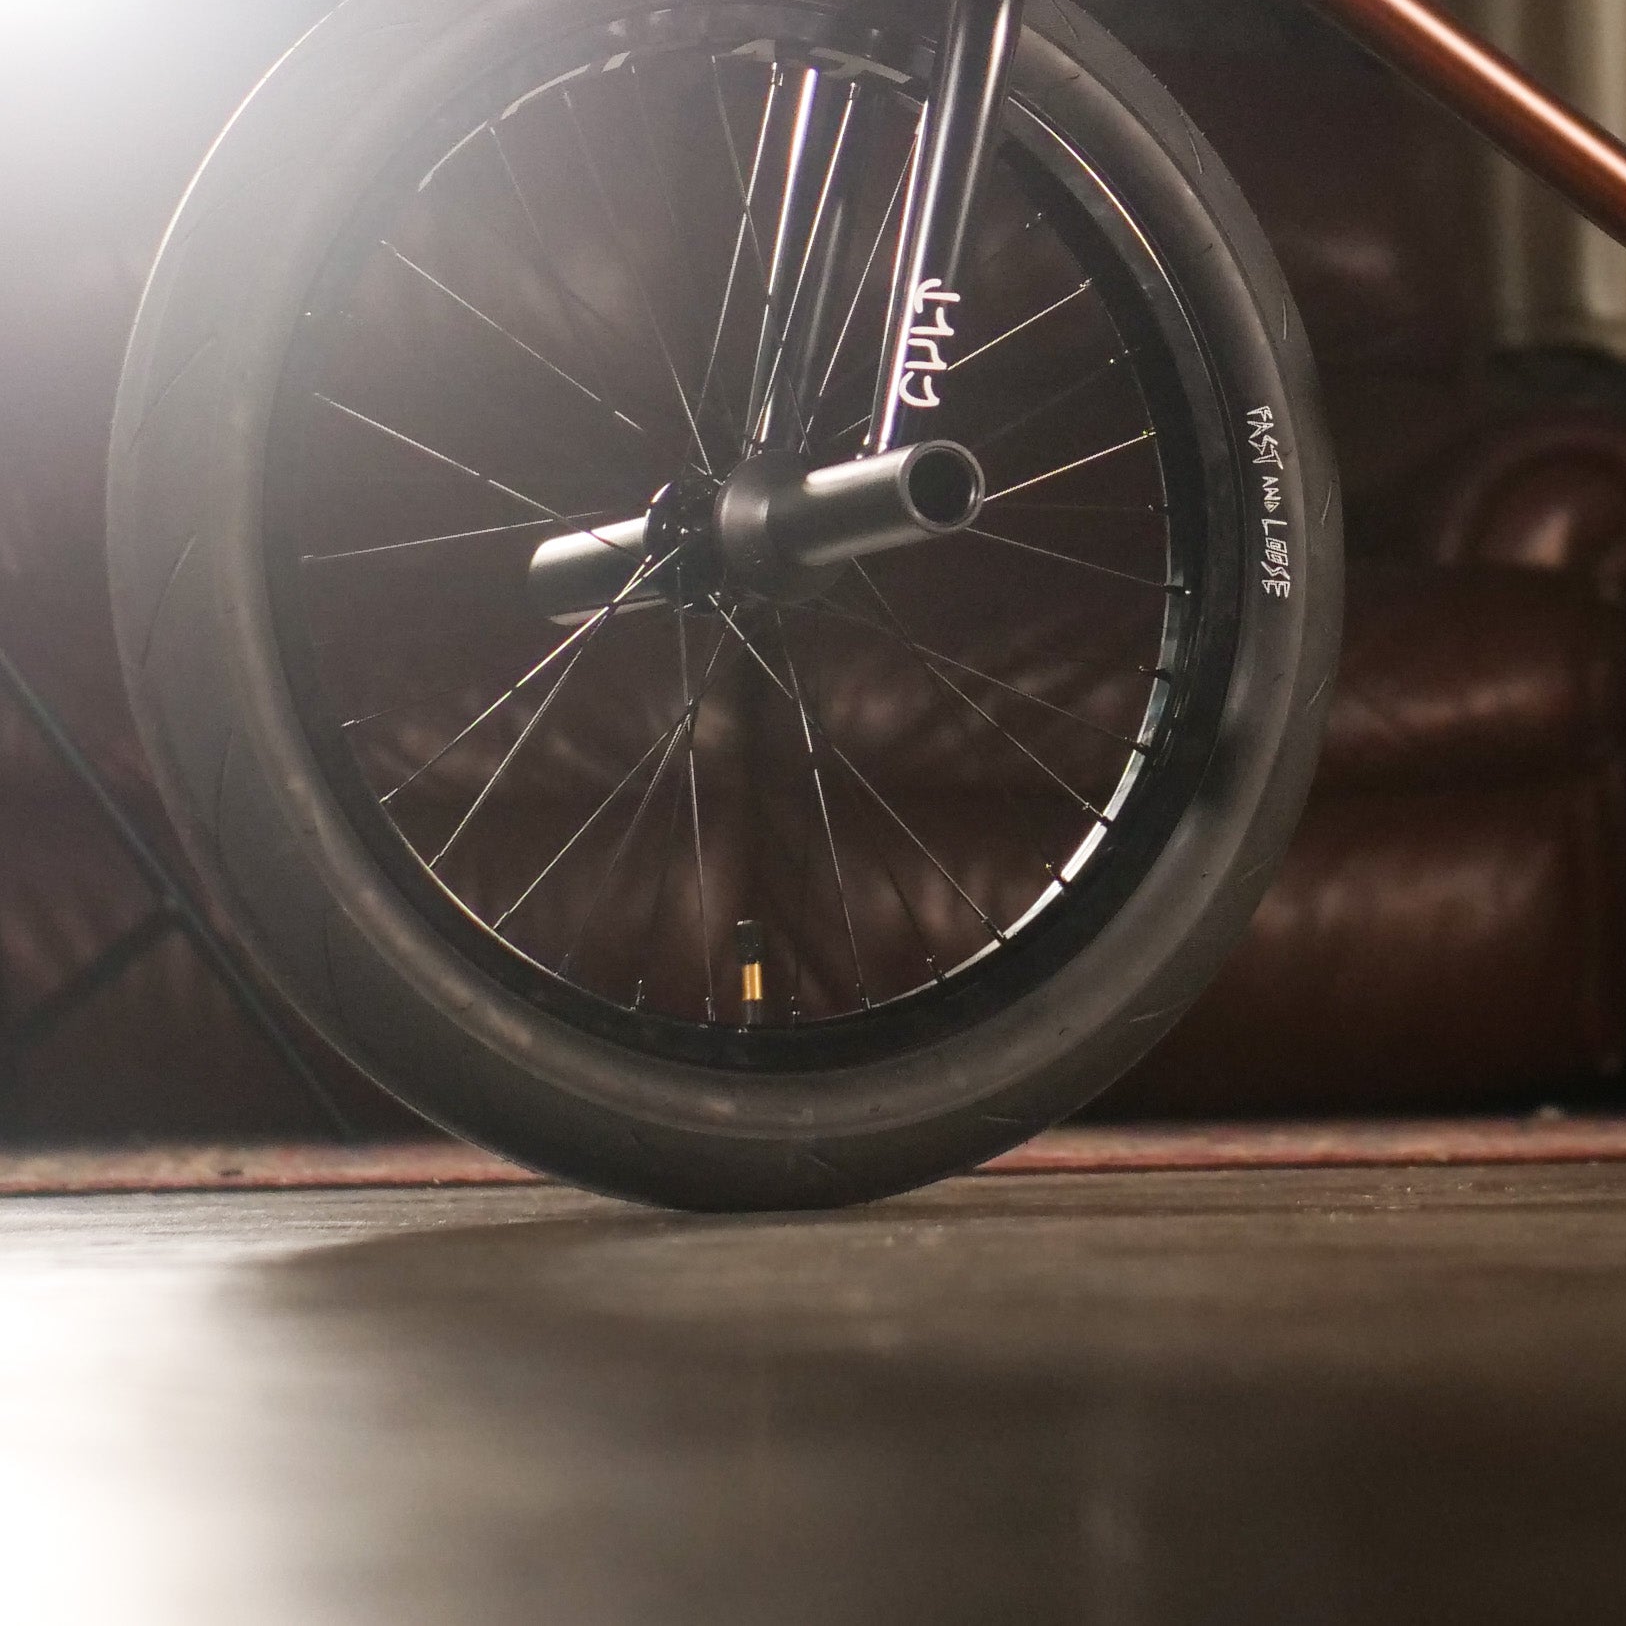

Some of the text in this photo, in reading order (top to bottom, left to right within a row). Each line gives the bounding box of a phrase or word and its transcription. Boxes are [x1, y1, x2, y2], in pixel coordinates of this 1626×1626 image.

[898, 278, 961, 408] CULT
[1246, 405, 1291, 600] FAST AND LOOSE
